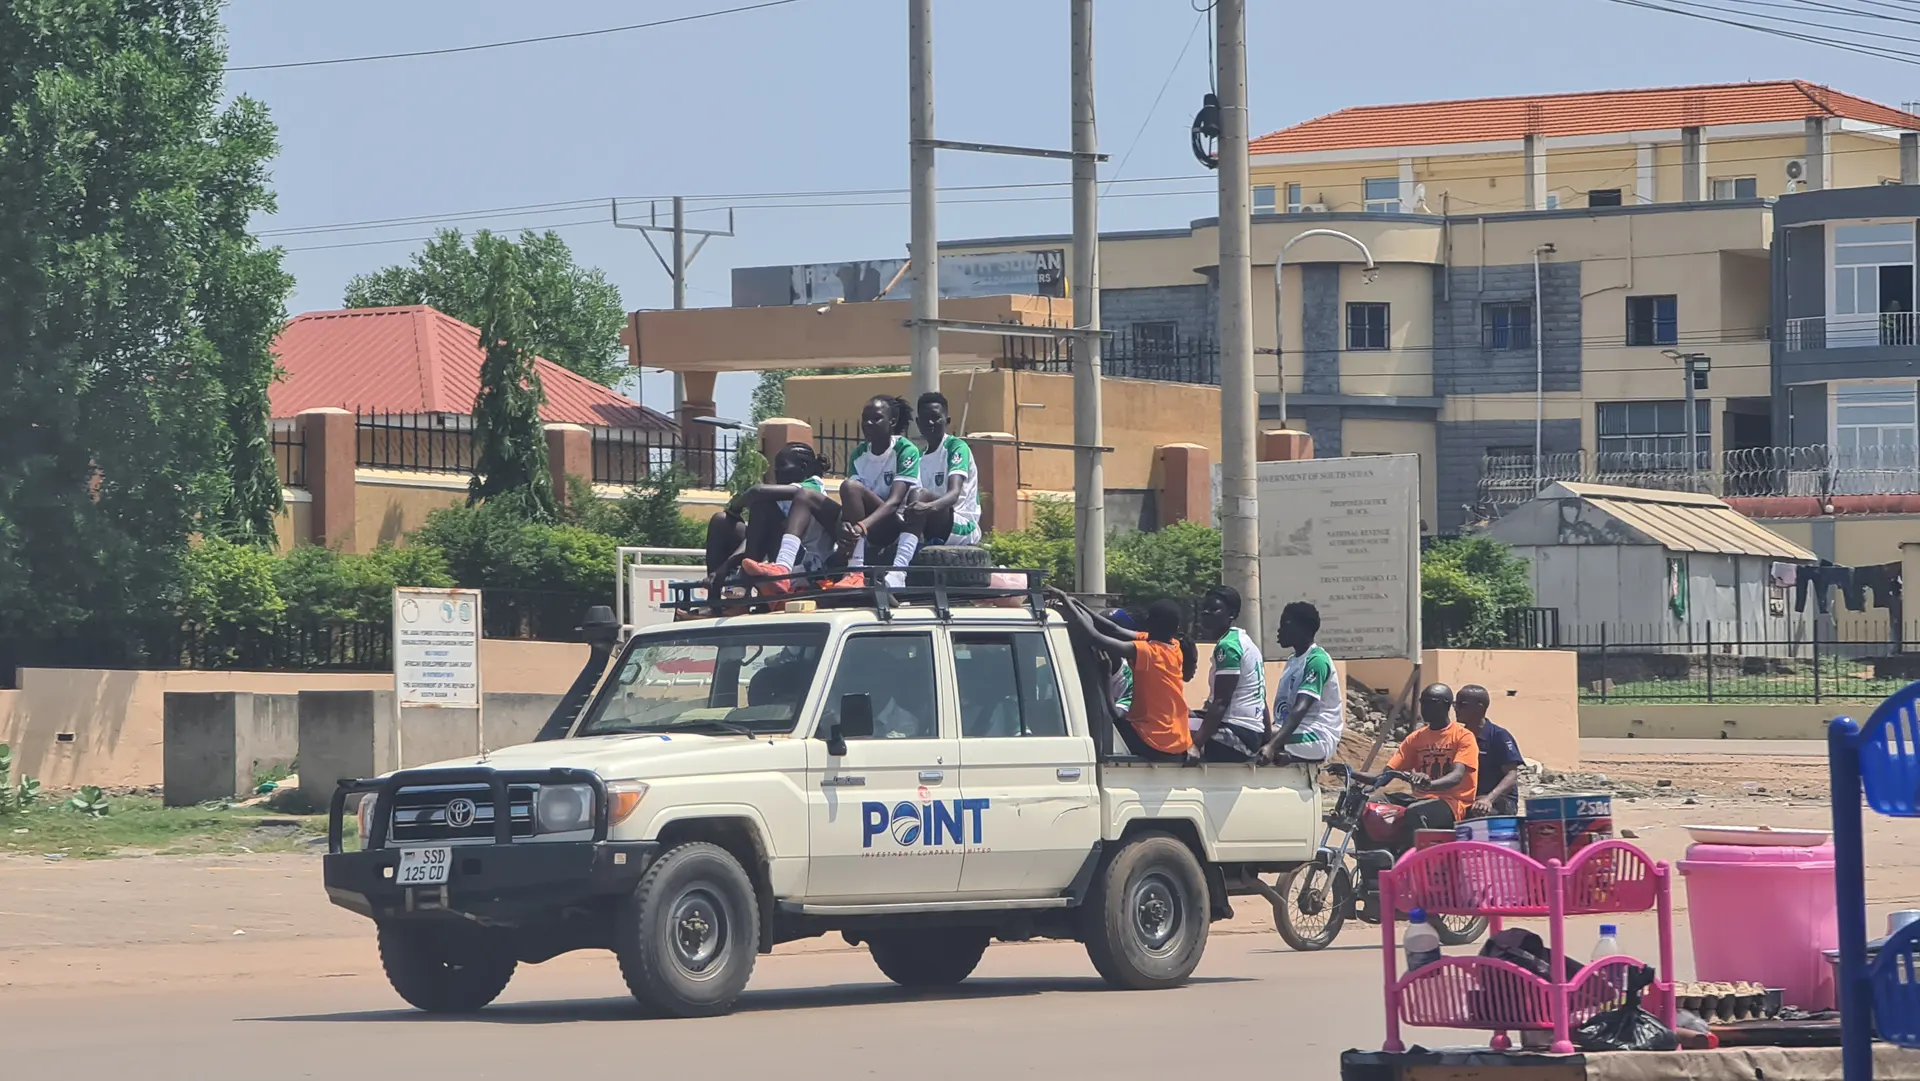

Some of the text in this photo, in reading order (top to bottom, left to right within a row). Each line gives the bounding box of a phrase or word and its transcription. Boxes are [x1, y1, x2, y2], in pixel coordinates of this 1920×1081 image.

[1257, 473, 1307, 483] OVERNMENT
[1320, 471, 1346, 479] SOUTH
[861, 798, 990, 848] POINT
[423, 849, 446, 864] SSD
[861, 850, 913, 858] INVESTMENT
[404, 865, 445, 881] 125 CD
